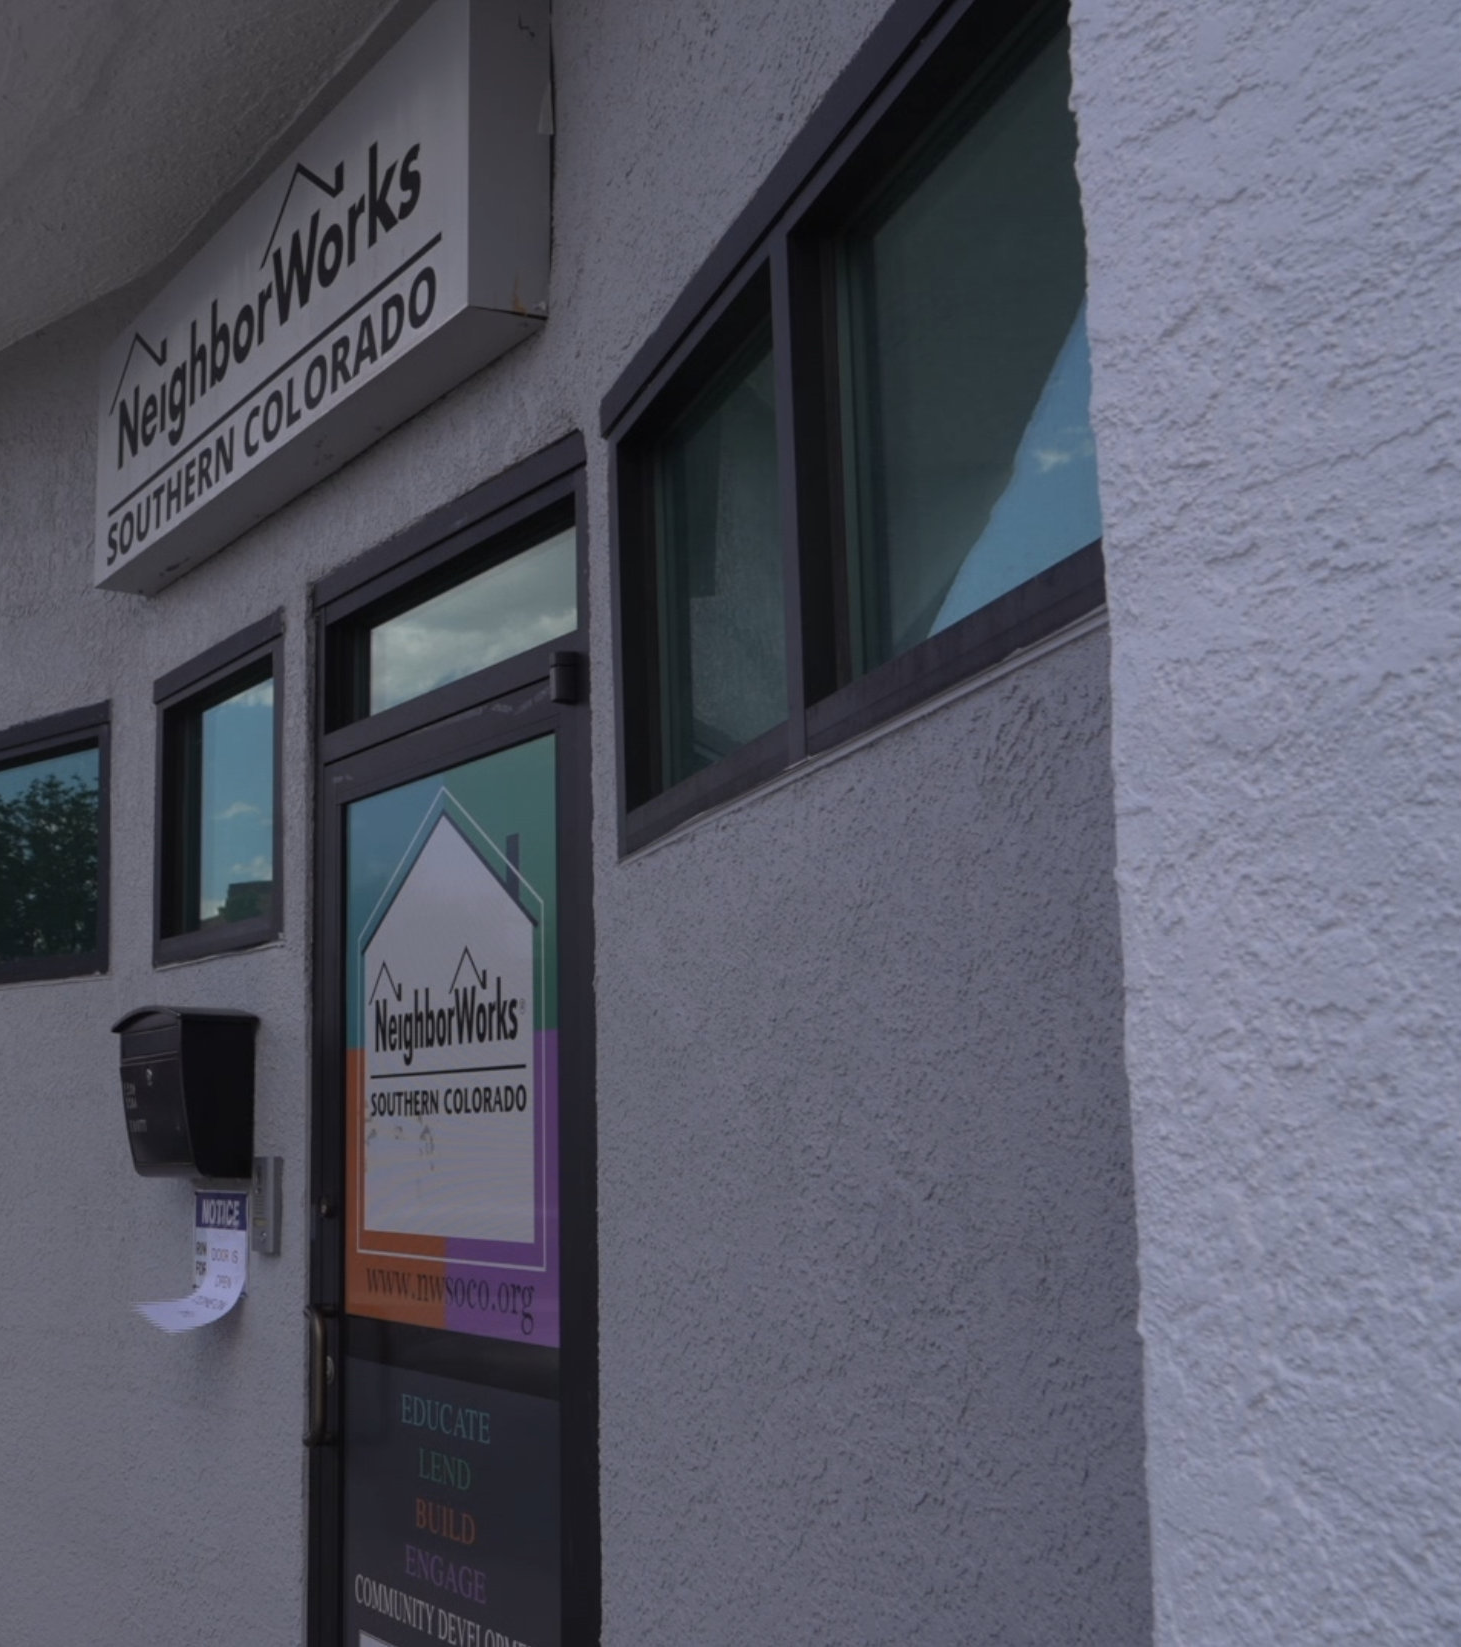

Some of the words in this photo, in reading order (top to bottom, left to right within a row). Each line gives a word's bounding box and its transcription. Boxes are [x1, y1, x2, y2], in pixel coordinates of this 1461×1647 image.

[111, 143, 420, 470] NeighborWorks
[107, 427, 234, 566] SOUTHERN
[243, 266, 437, 457] COLORADO
[375, 976, 518, 1065] NeighborWorks
[370, 1088, 439, 1117] SOUTHERN
[443, 1083, 527, 1114] COLORADO
[202, 1200, 240, 1226] NOTICE
[366, 1267, 534, 1335] www.nwsoco.org
[401, 1393, 491, 1445] EDUCATE
[417, 1447, 472, 1491] LEND
[415, 1498, 476, 1545] BUILD
[404, 1544, 487, 1604] ENGAGE
[354, 1573, 434, 1636] COMMUNITY
